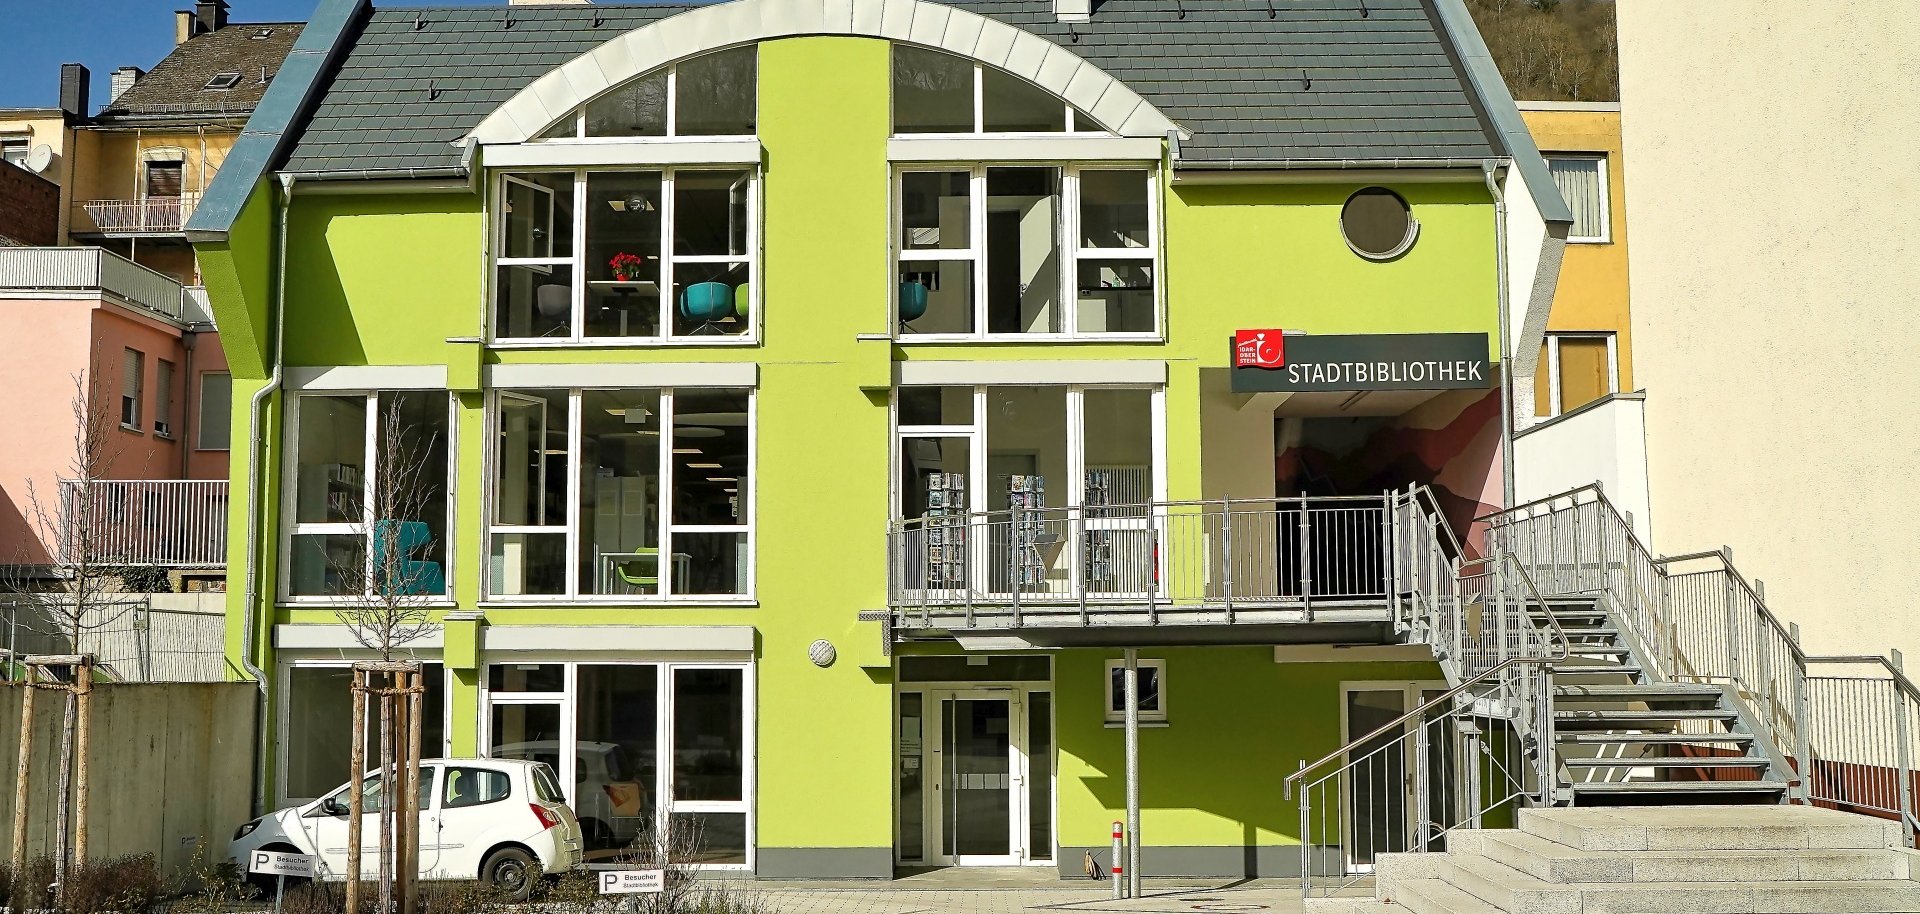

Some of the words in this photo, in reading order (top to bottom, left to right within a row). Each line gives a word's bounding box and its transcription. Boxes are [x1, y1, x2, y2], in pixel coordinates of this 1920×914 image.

[1288, 360, 1482, 383] STADTBIBLIOTHEK
[255, 853, 270, 870] P
[276, 855, 309, 863] Besucher
[604, 874, 618, 891] P
